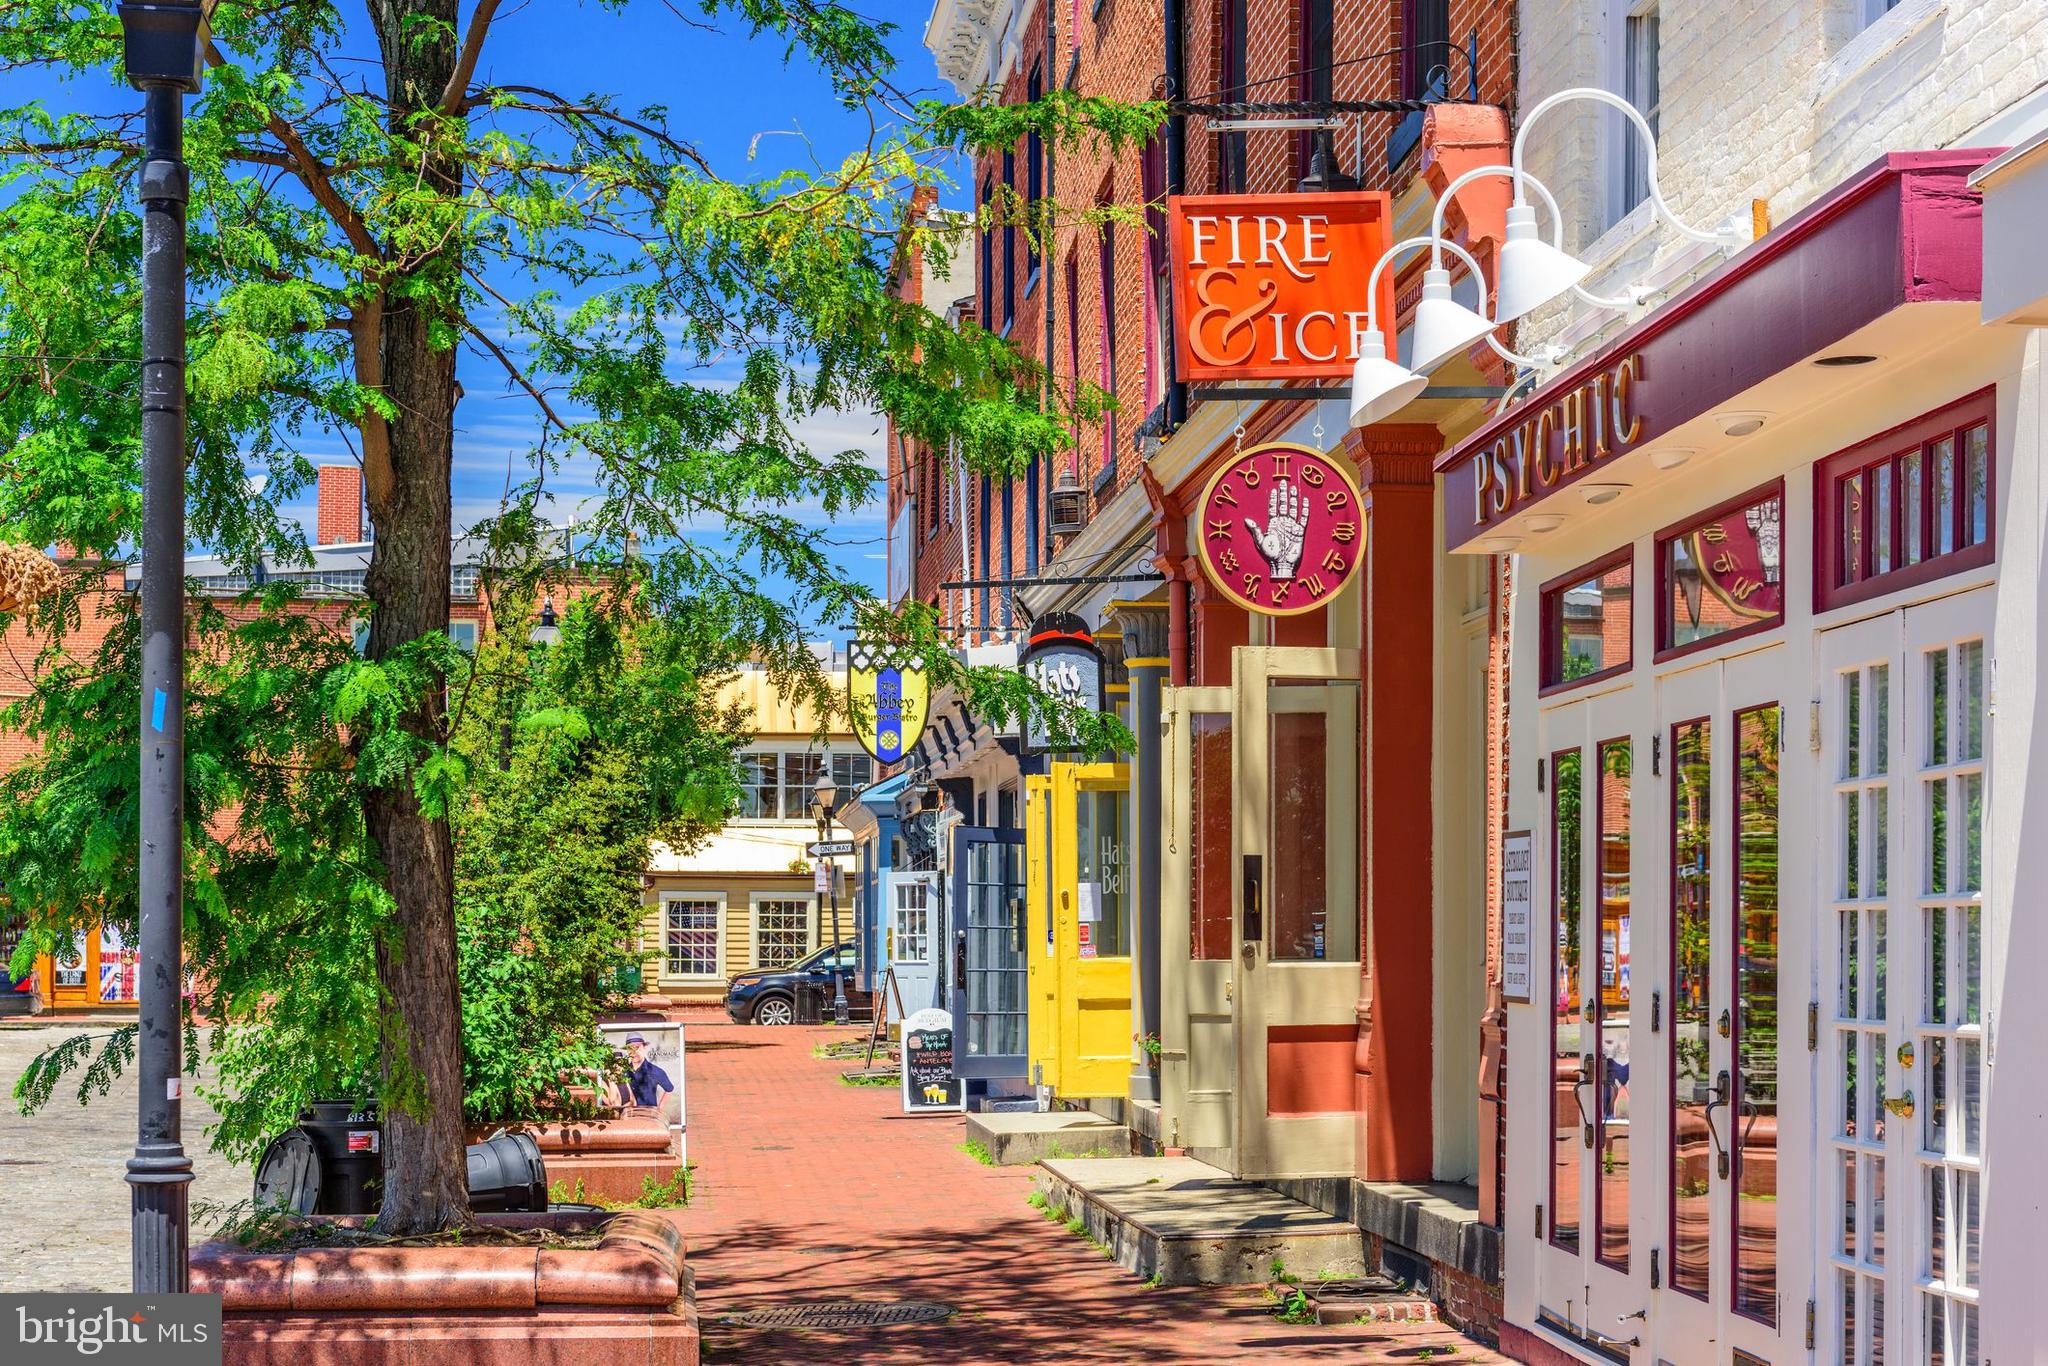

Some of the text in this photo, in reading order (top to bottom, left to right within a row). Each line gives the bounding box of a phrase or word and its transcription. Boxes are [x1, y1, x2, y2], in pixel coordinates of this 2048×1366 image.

[1186, 214, 1332, 279] FIRE
[1188, 266, 1278, 367] &
[1473, 354, 1641, 526] PSYCHIC
[1026, 661, 1081, 695] Hats
[863, 691, 915, 713] Abbey
[819, 845, 834, 853] ONE
[1101, 865, 1131, 895] Belf
